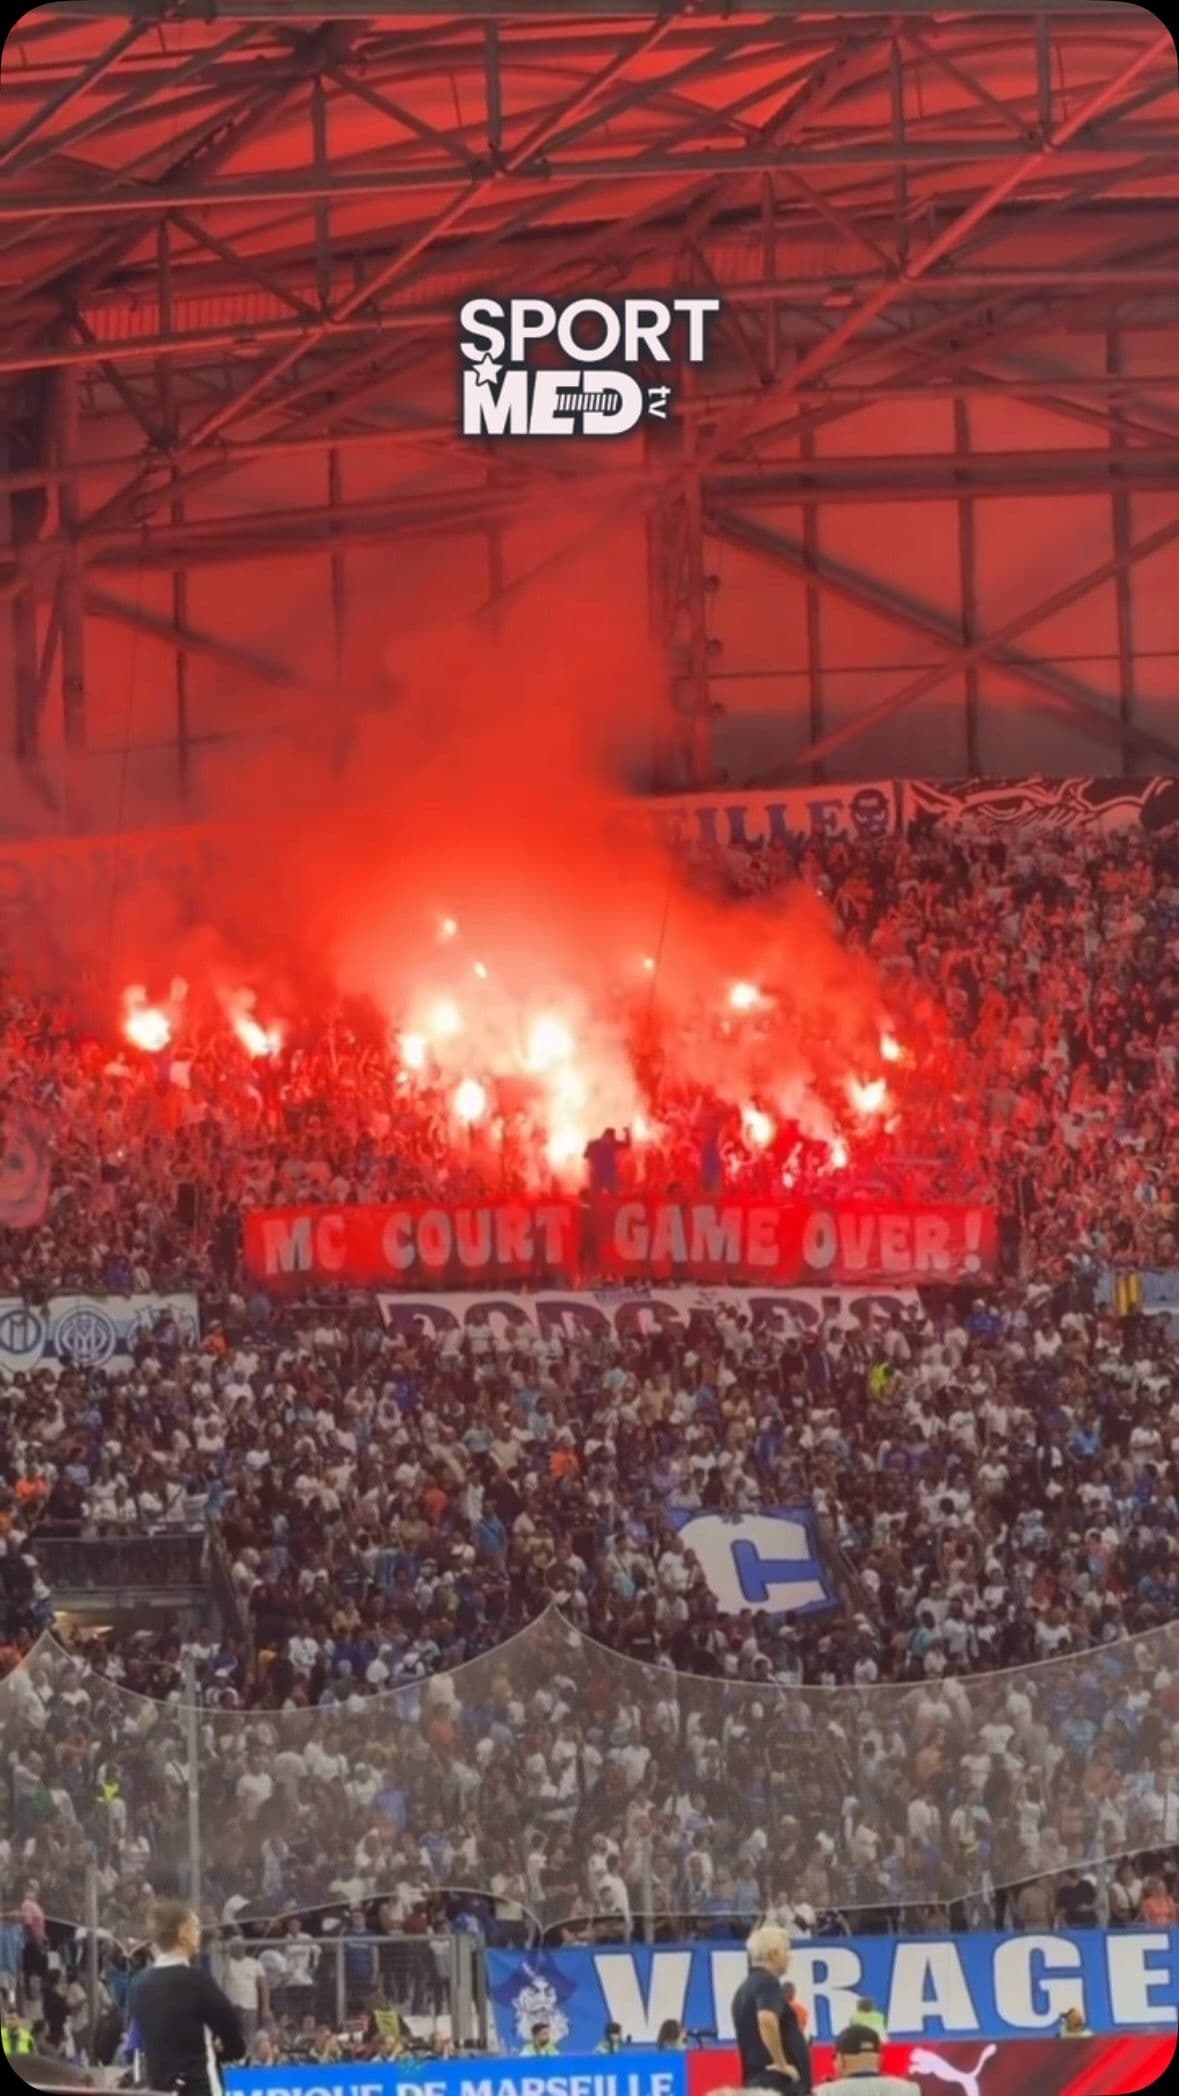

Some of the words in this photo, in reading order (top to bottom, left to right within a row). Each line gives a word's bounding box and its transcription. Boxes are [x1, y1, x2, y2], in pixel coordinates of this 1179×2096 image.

[262, 1215, 348, 1275] MC
[382, 1206, 571, 1269] COURT
[614, 1203, 781, 1266] GAME
[593, 1933, 1178, 2042] VIRAGE
